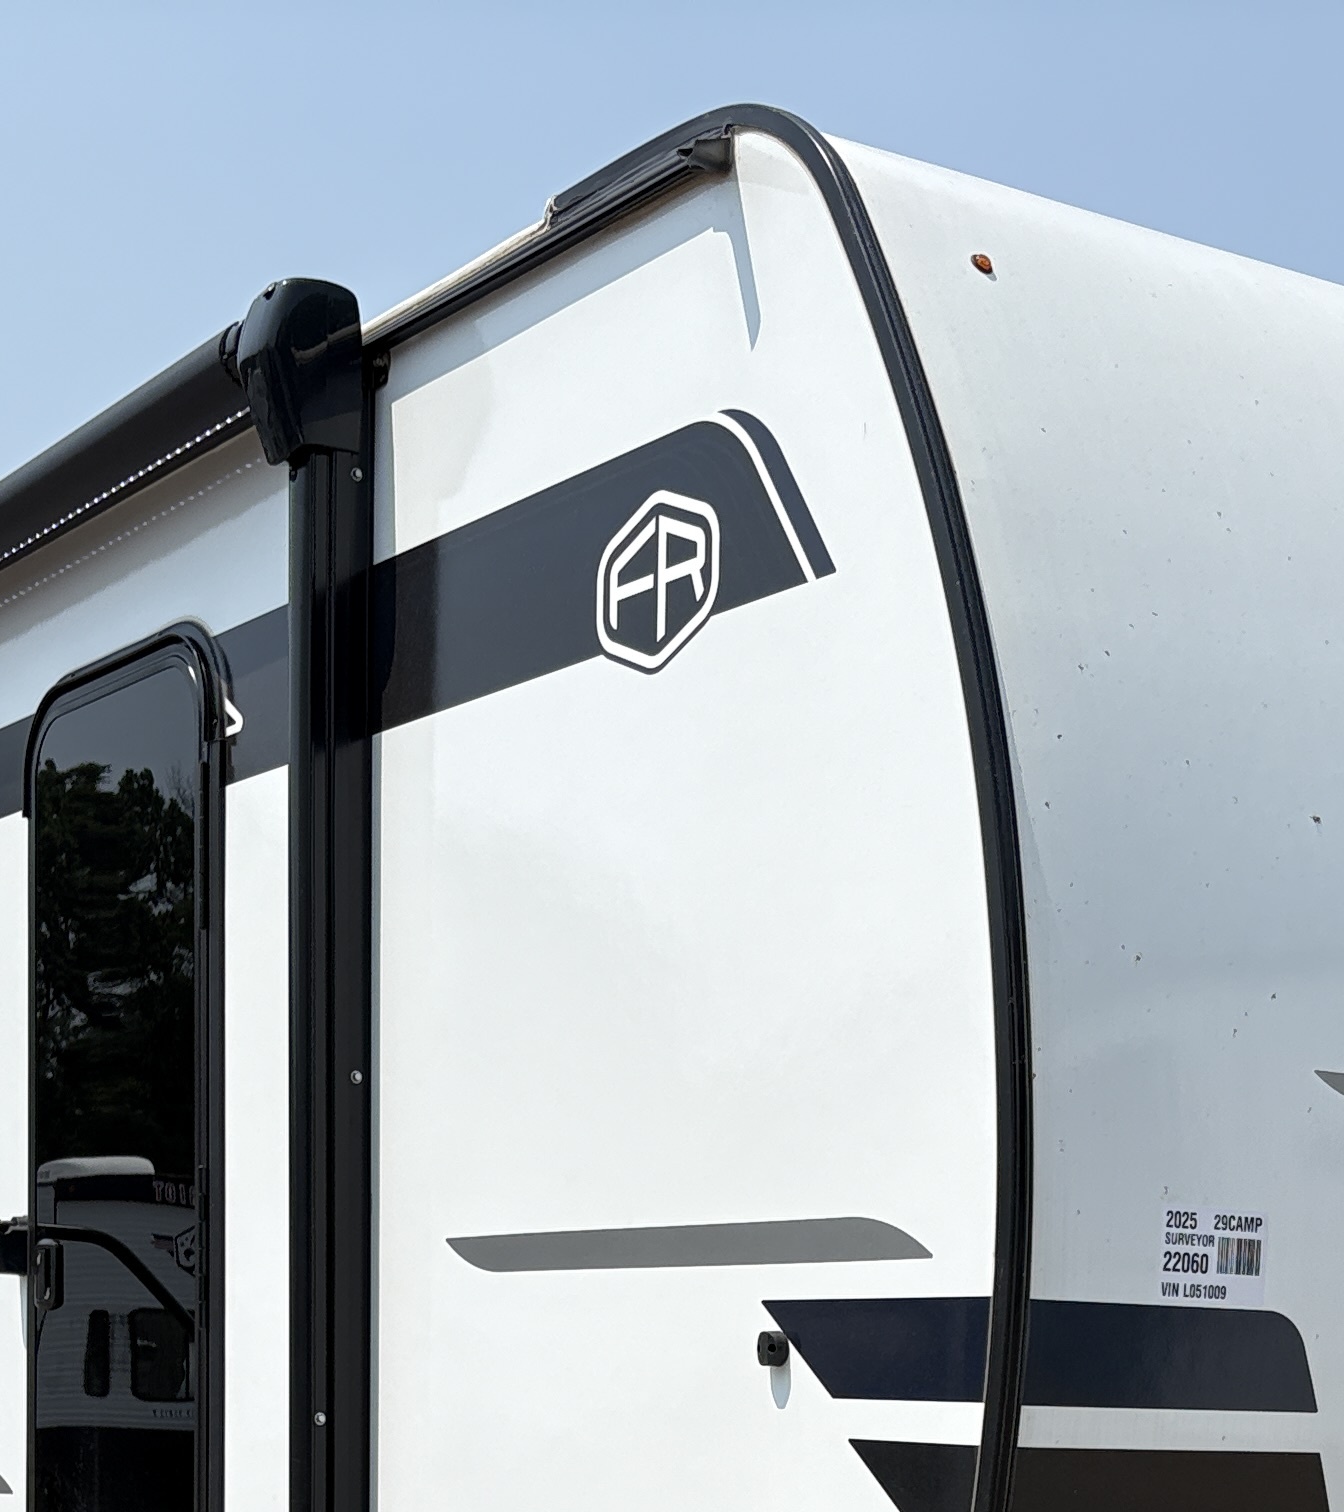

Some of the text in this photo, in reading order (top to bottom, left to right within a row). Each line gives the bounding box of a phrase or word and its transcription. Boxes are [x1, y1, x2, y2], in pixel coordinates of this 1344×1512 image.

[1165, 1210, 1263, 1234] 2025 29CAMP
[1164, 1231, 1216, 1248] SURVEYOR
[1162, 1250, 1209, 1275] 22060
[1161, 1281, 1180, 1298] VIN
